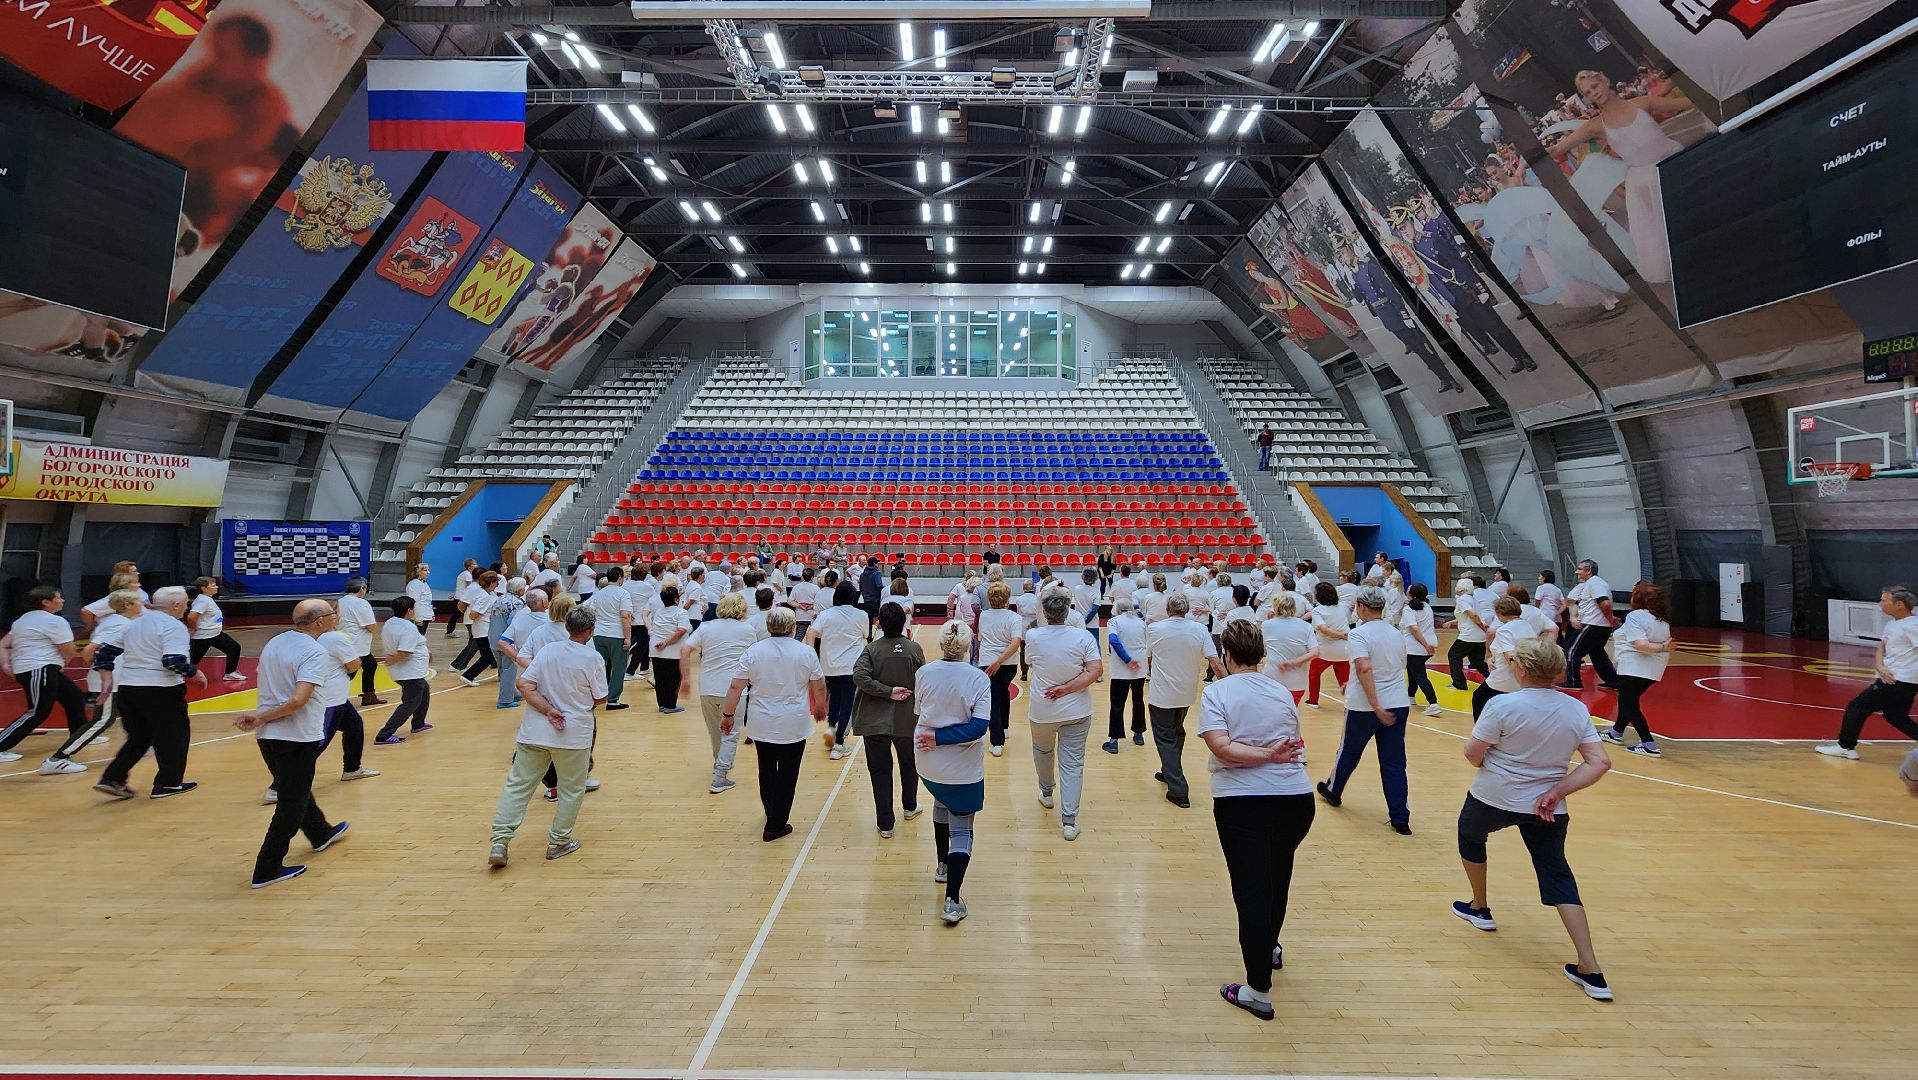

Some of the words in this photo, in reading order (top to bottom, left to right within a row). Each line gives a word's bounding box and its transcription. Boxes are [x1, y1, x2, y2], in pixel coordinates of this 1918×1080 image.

[46, 16, 156, 82] ЛУЧШЕ
[1829, 102, 1867, 128] СЧЕТ
[1822, 138, 1887, 173] ТАЙМ-АУТЫ
[1846, 229, 1882, 248] ФОЛЫ
[1800, 417, 1814, 425] FON
[43, 444, 191, 469] АДМИНИСТРАЦИЯ
[41, 459, 176, 480] БОГОРОДСКОГО
[39, 474, 155, 492] ГОРОДСКОГО
[35, 489, 108, 503] ОКРУГА
